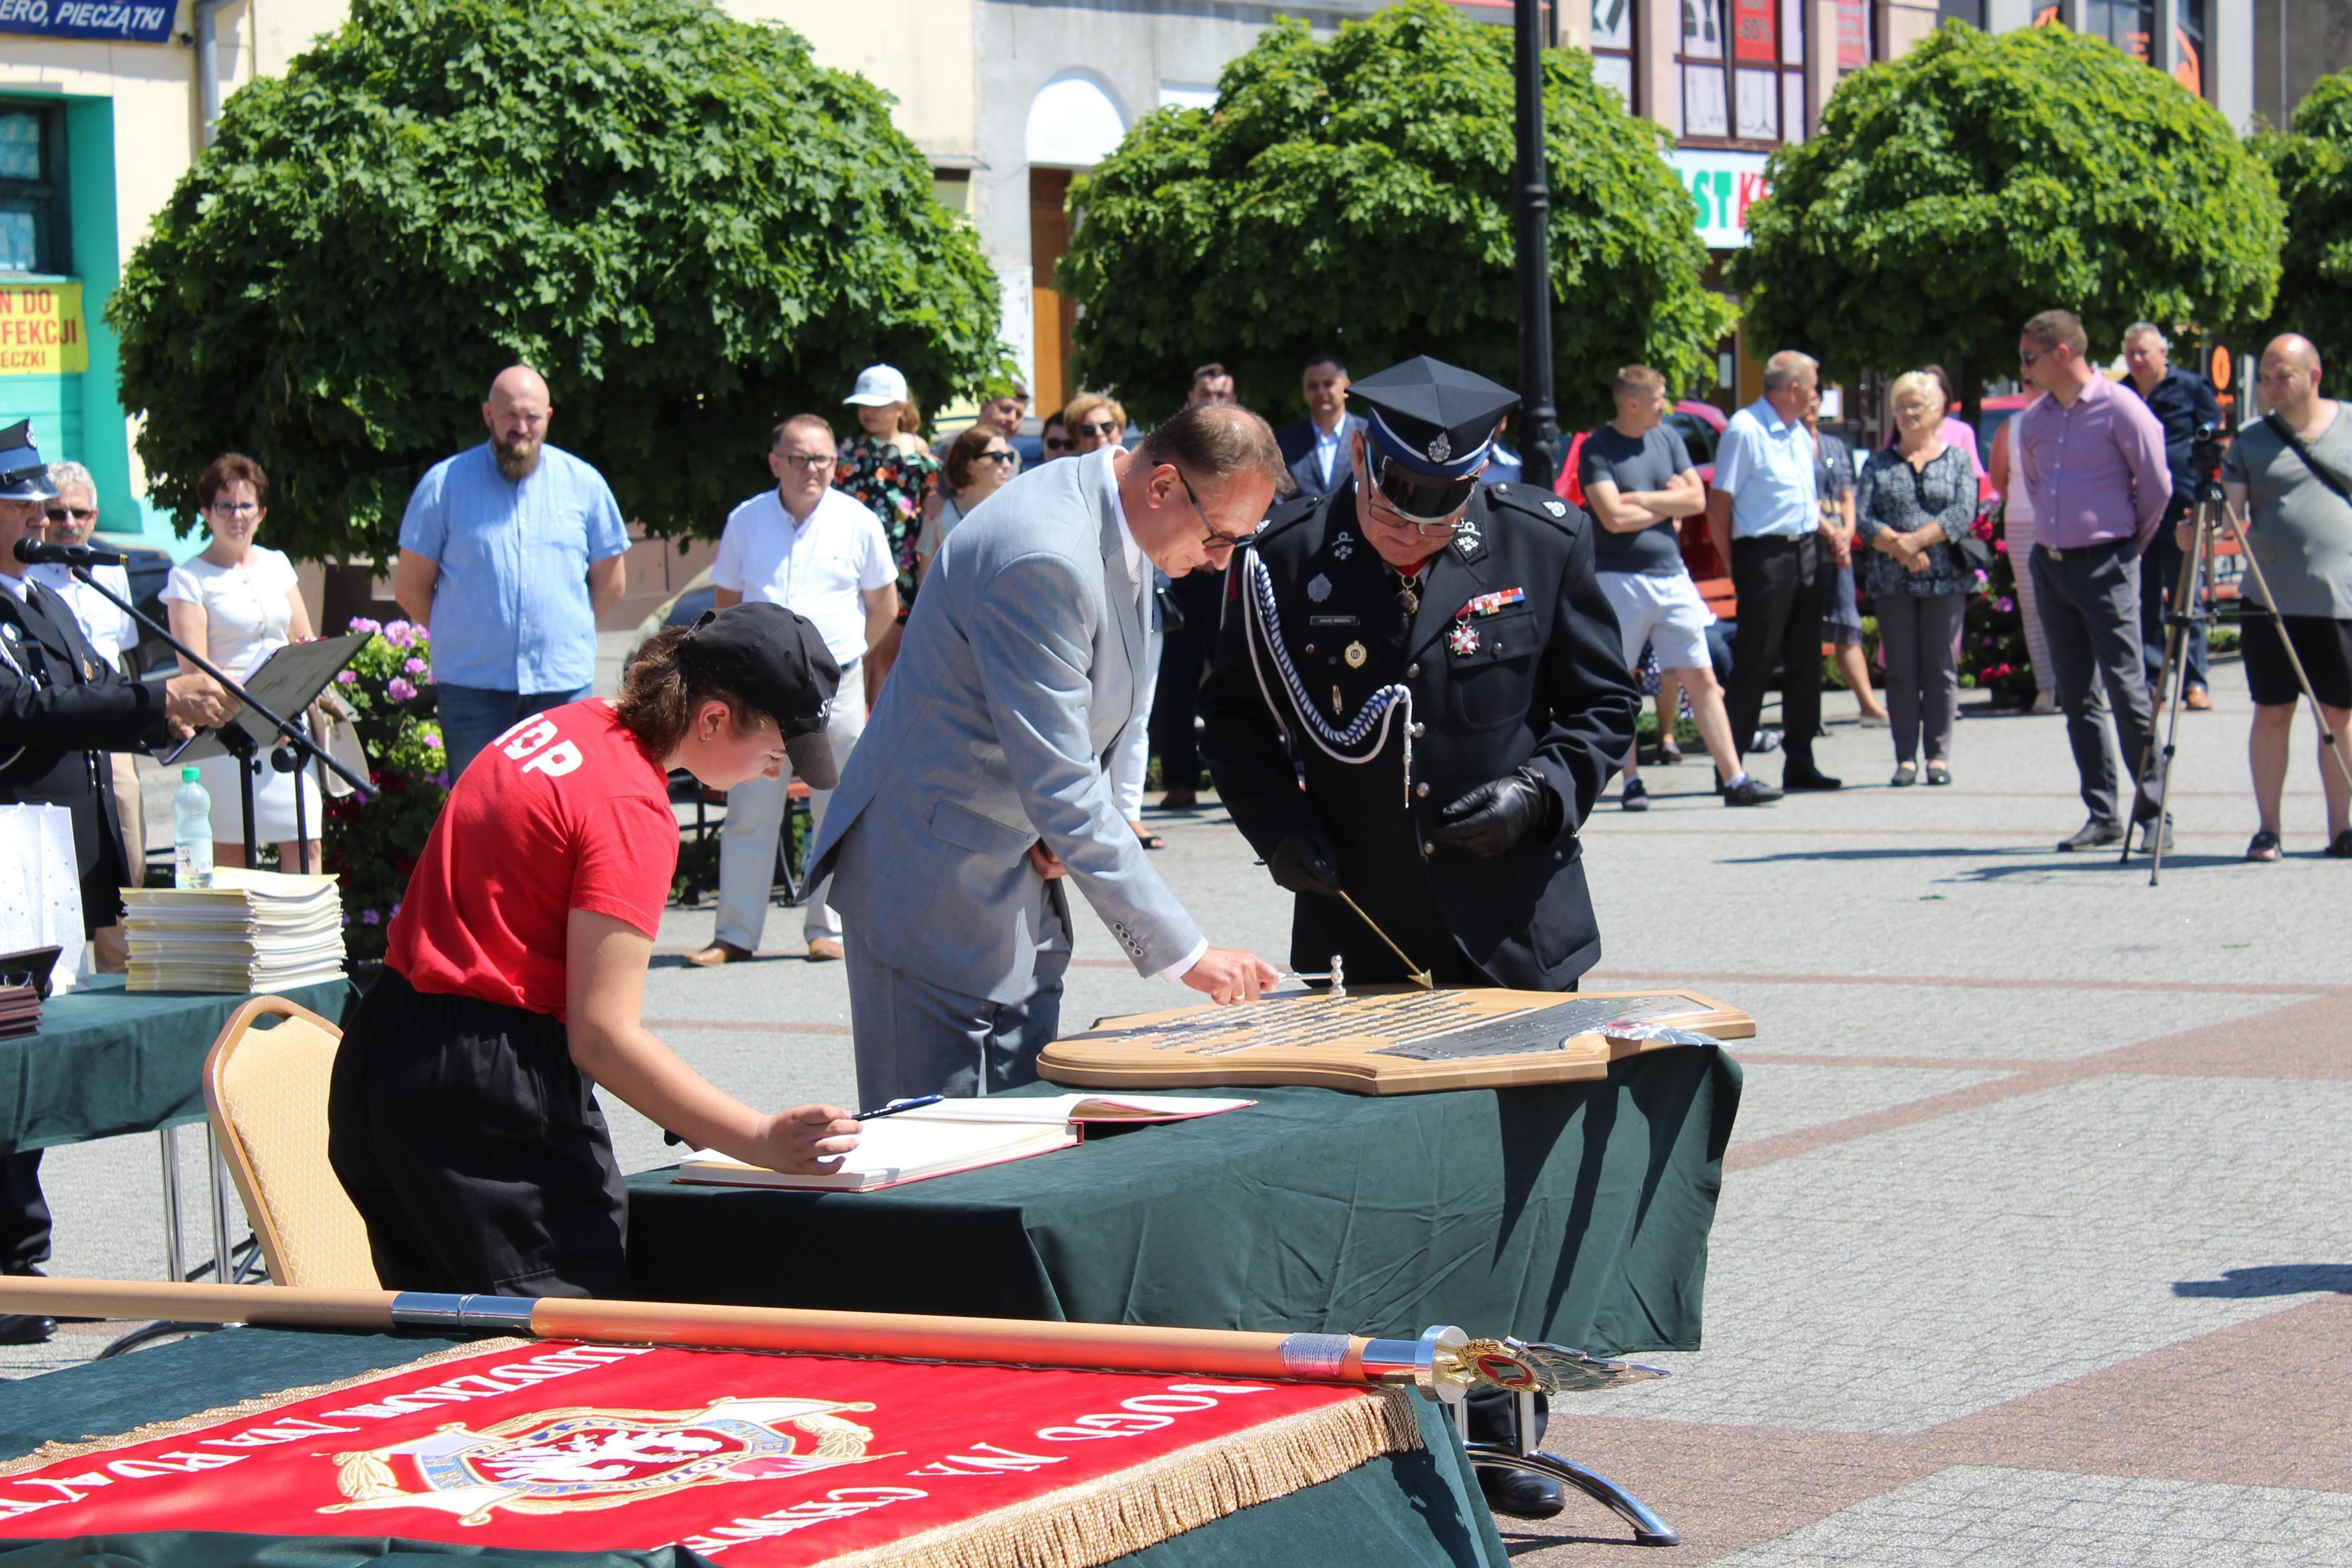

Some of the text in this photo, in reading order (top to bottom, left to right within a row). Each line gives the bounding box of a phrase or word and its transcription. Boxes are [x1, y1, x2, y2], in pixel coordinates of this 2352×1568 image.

[55, 1, 165, 34] PIECZĄTKI
[23, 289, 51, 314] DO
[1, 319, 76, 345] FEKCJI
[1, 351, 45, 367] ECZKI
[319, 1344, 655, 1418] LUDZIOM
[199, 1417, 360, 1447] NA
[906, 1442, 1068, 1477] NA
